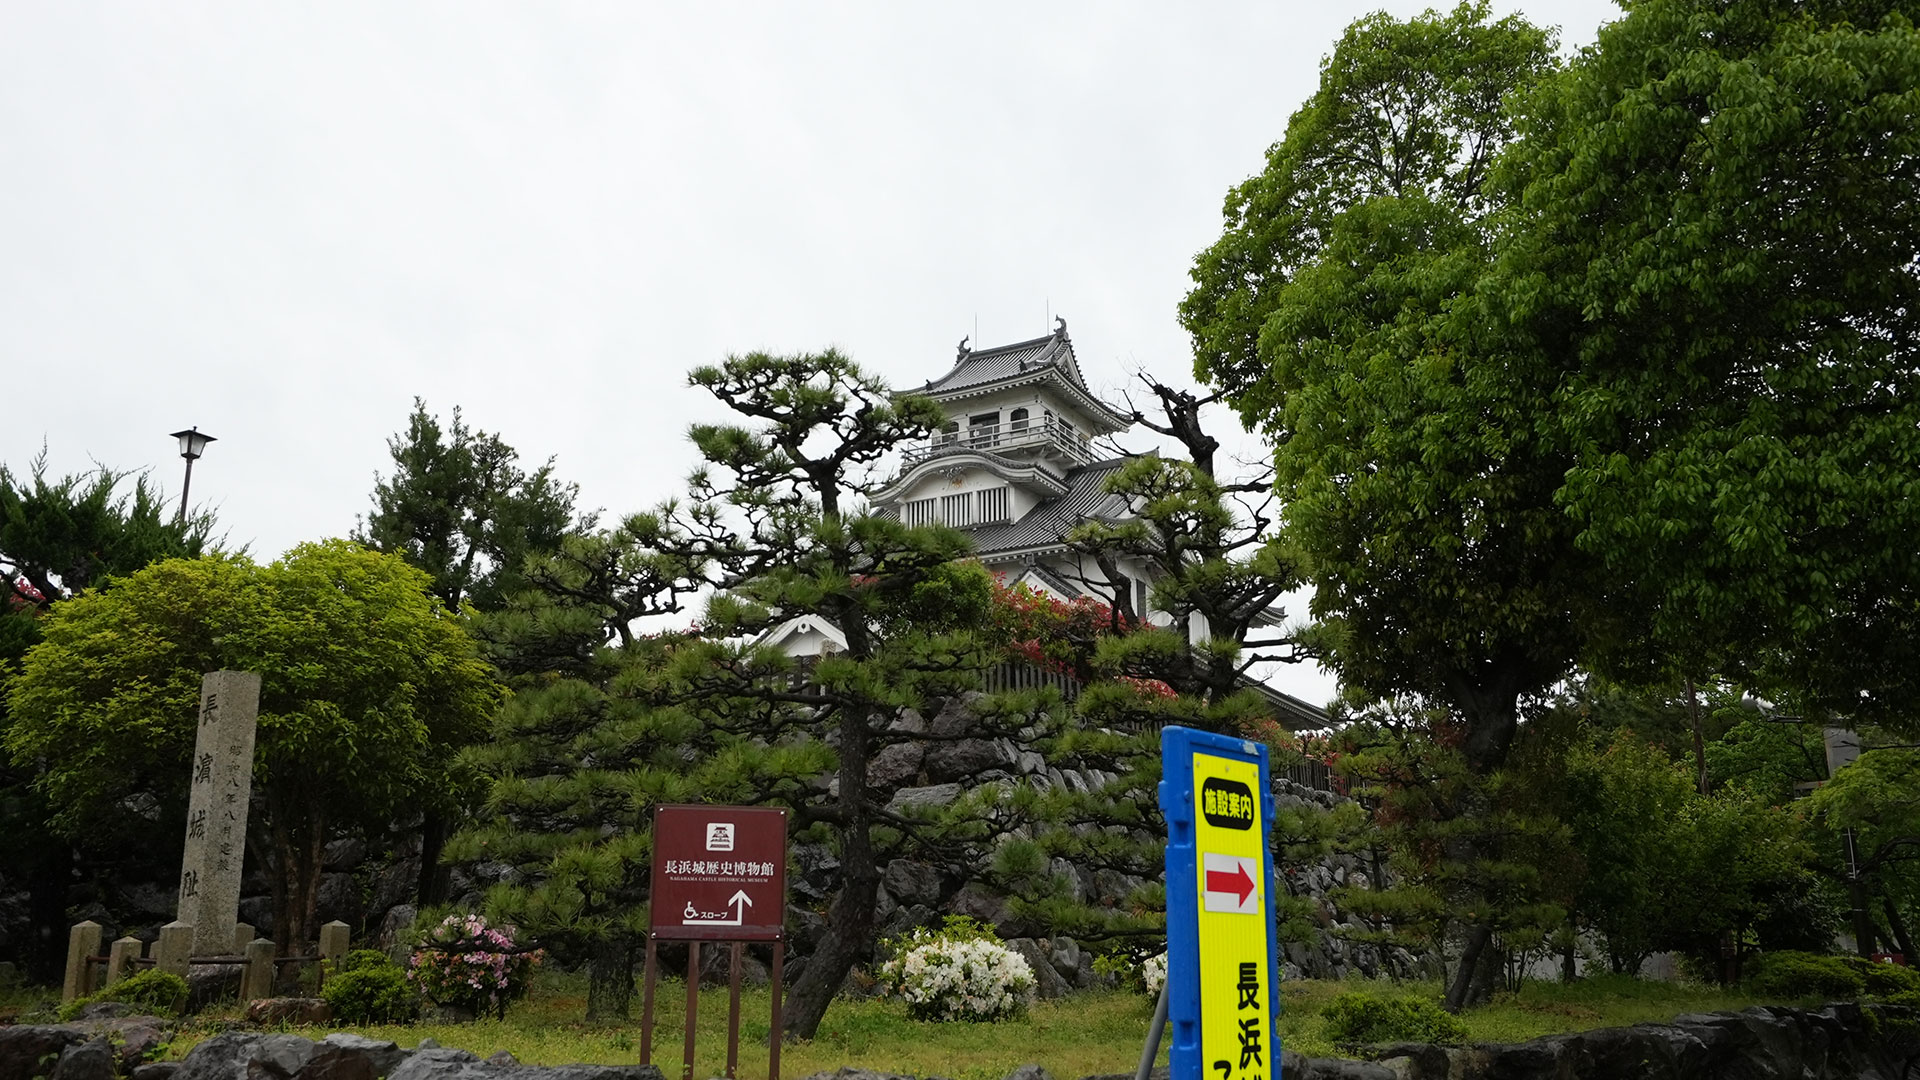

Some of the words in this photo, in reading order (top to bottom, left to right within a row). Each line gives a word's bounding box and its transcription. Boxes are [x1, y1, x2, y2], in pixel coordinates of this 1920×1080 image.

[1204, 787, 1253, 821] 施設案内
[664, 860, 775, 876] 長浜城歴史博物館
[700, 911, 729, 919] スロープ
[1237, 962, 1263, 1080] 長浜
